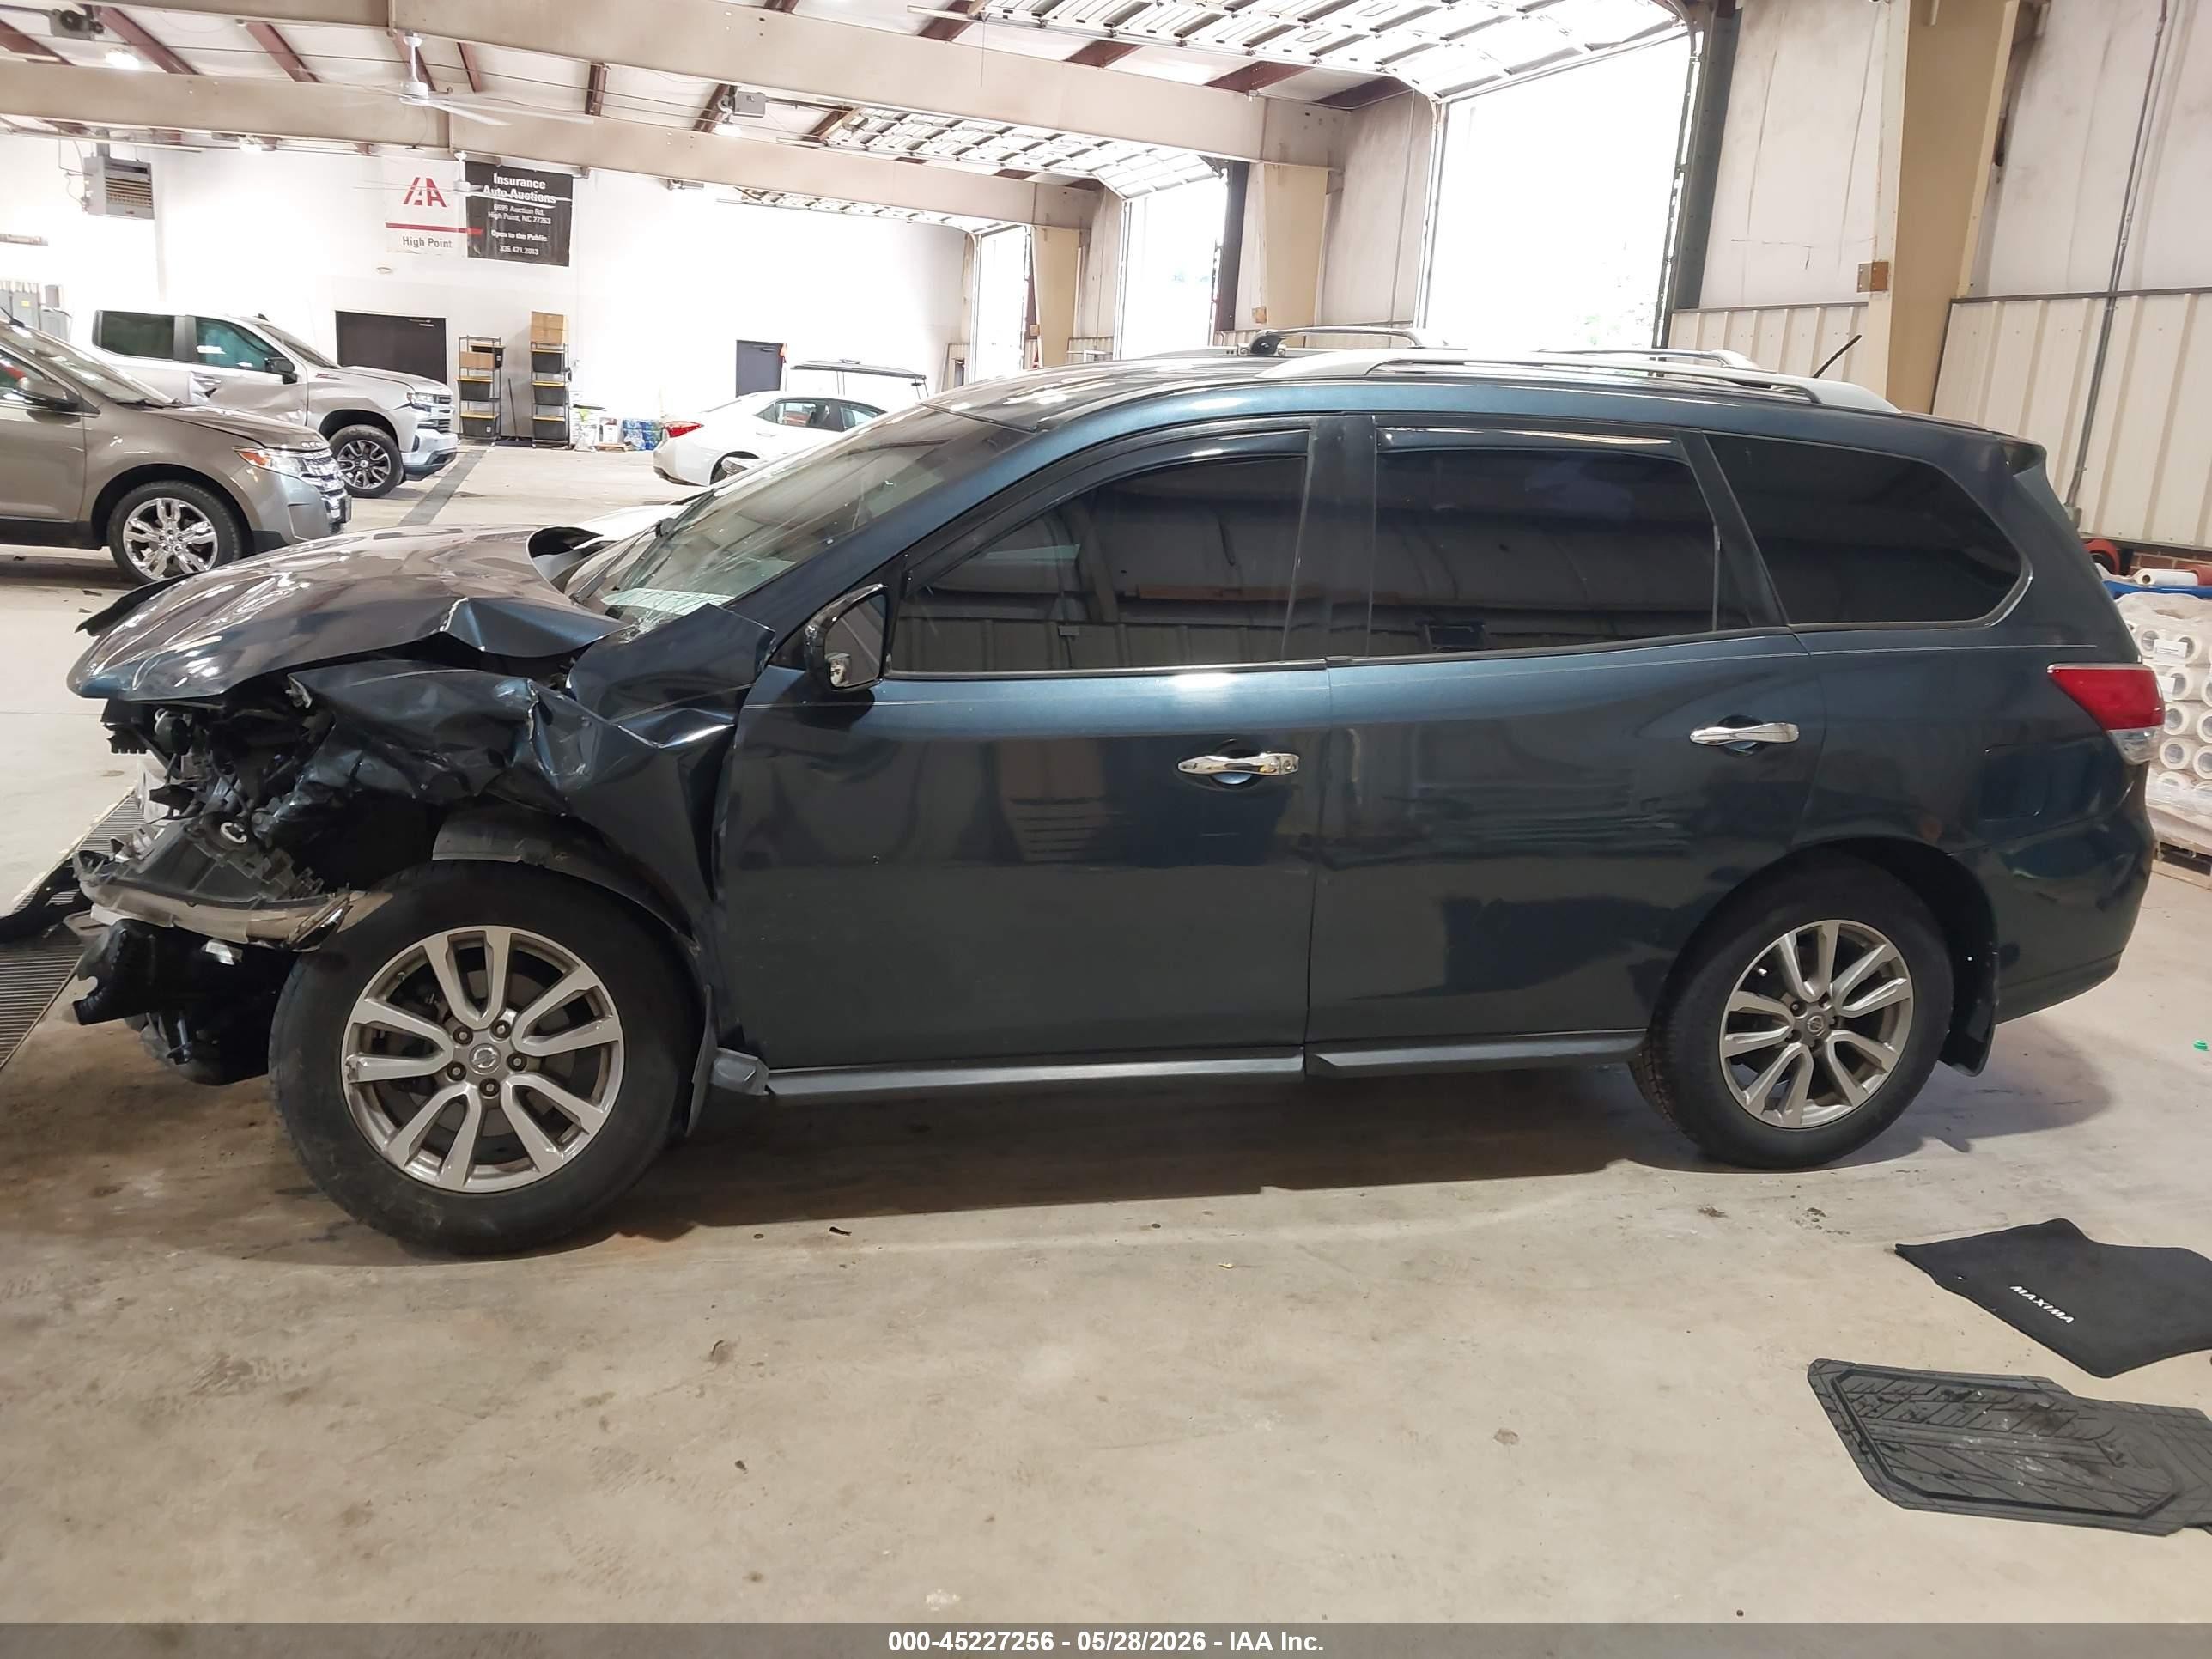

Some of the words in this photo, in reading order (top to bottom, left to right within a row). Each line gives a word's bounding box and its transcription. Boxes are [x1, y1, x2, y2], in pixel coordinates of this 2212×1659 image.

[493, 173, 547, 190] Insurance
[483, 185, 508, 198] Auto
[509, 188, 557, 204] Auctions
[488, 211, 502, 221] High
[402, 236, 425, 248] High
[428, 238, 453, 248] Point
[490, 229, 508, 239] Open
[526, 233, 548, 242] Public
[2008, 1285, 2075, 1324] MAXIMA
